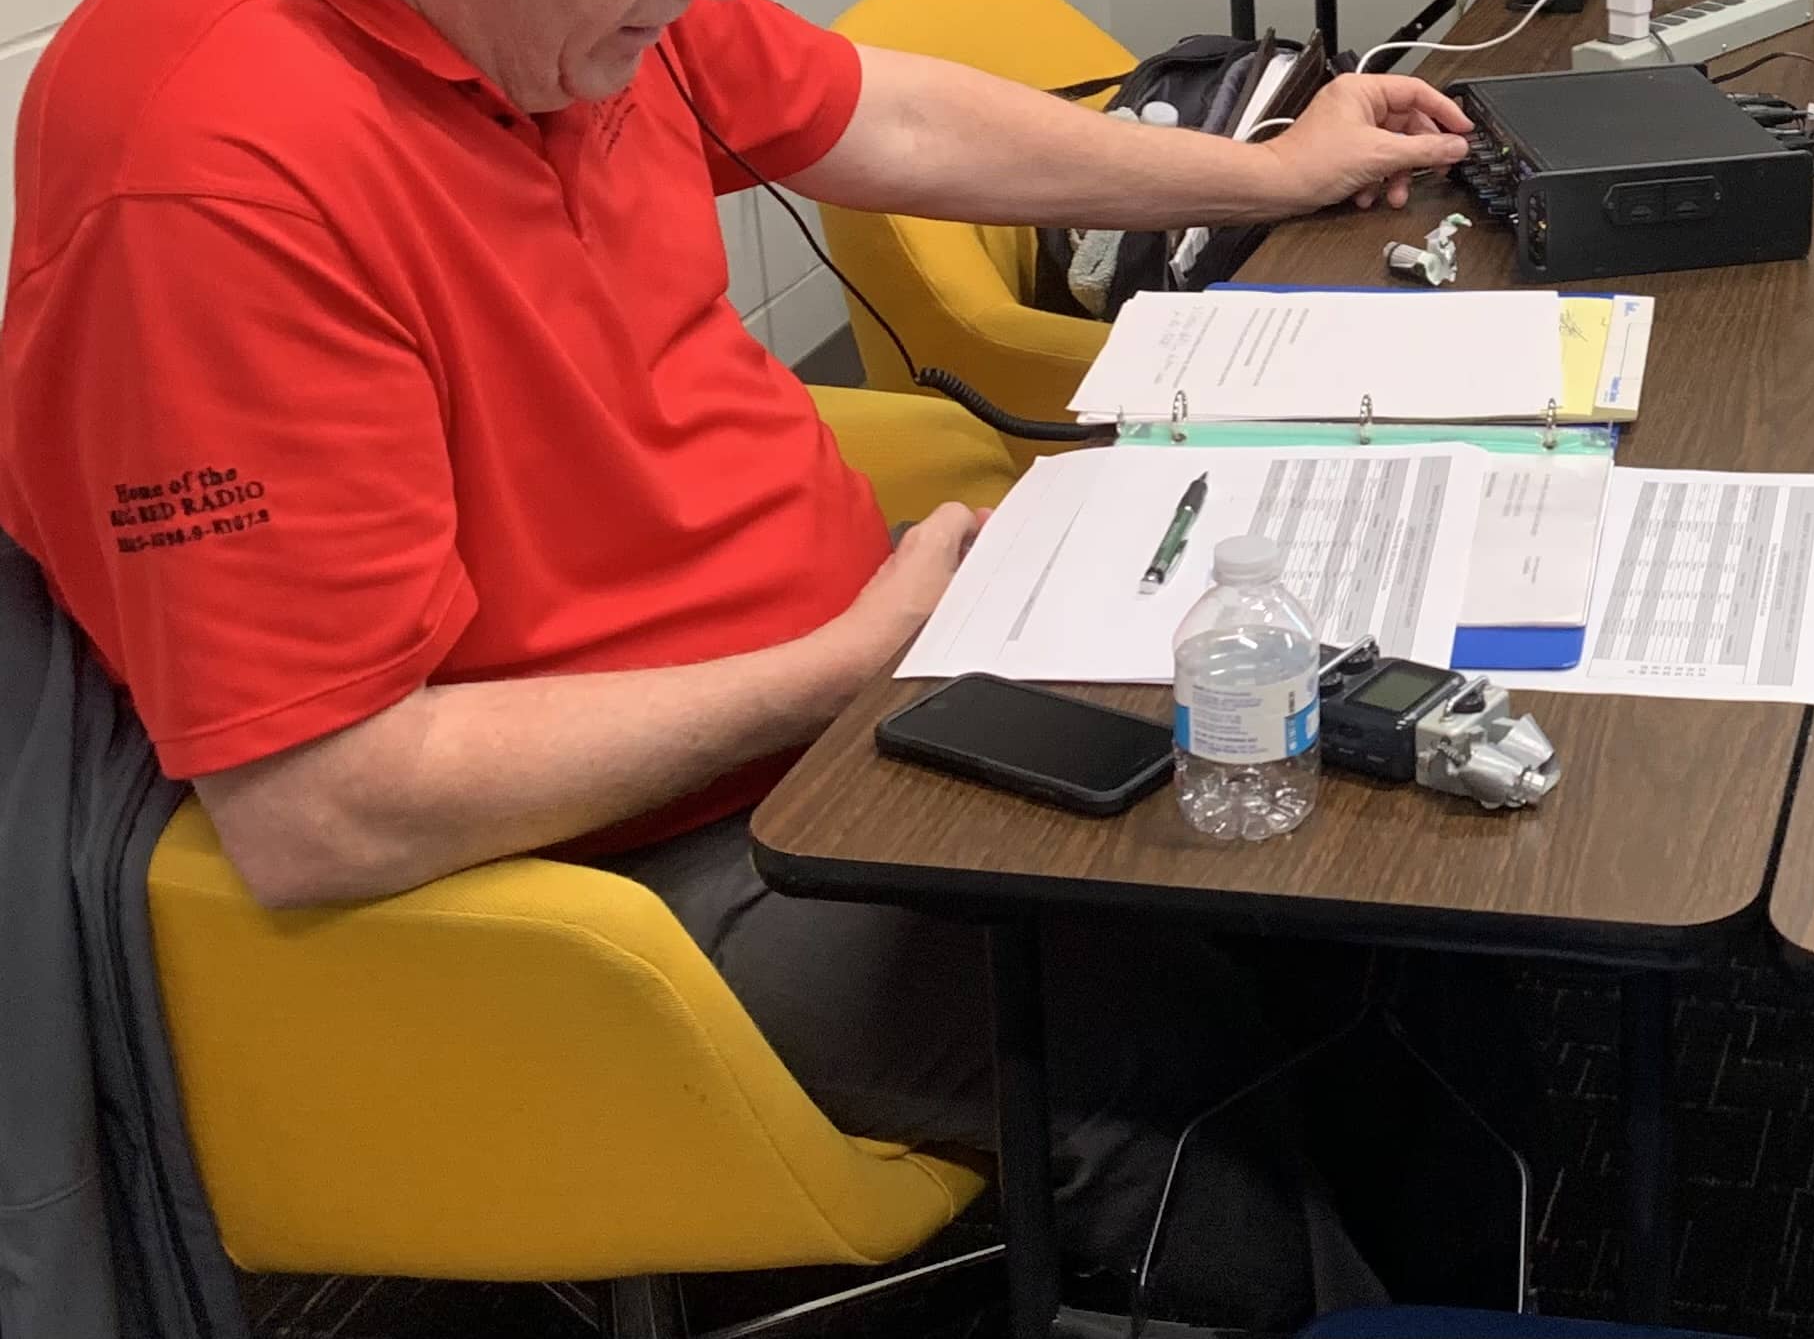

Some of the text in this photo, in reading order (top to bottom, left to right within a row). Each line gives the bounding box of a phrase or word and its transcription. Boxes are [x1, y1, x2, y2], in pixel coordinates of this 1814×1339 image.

[168, 471, 193, 495] of
[198, 466, 238, 488] the
[181, 481, 265, 516] RADIO
